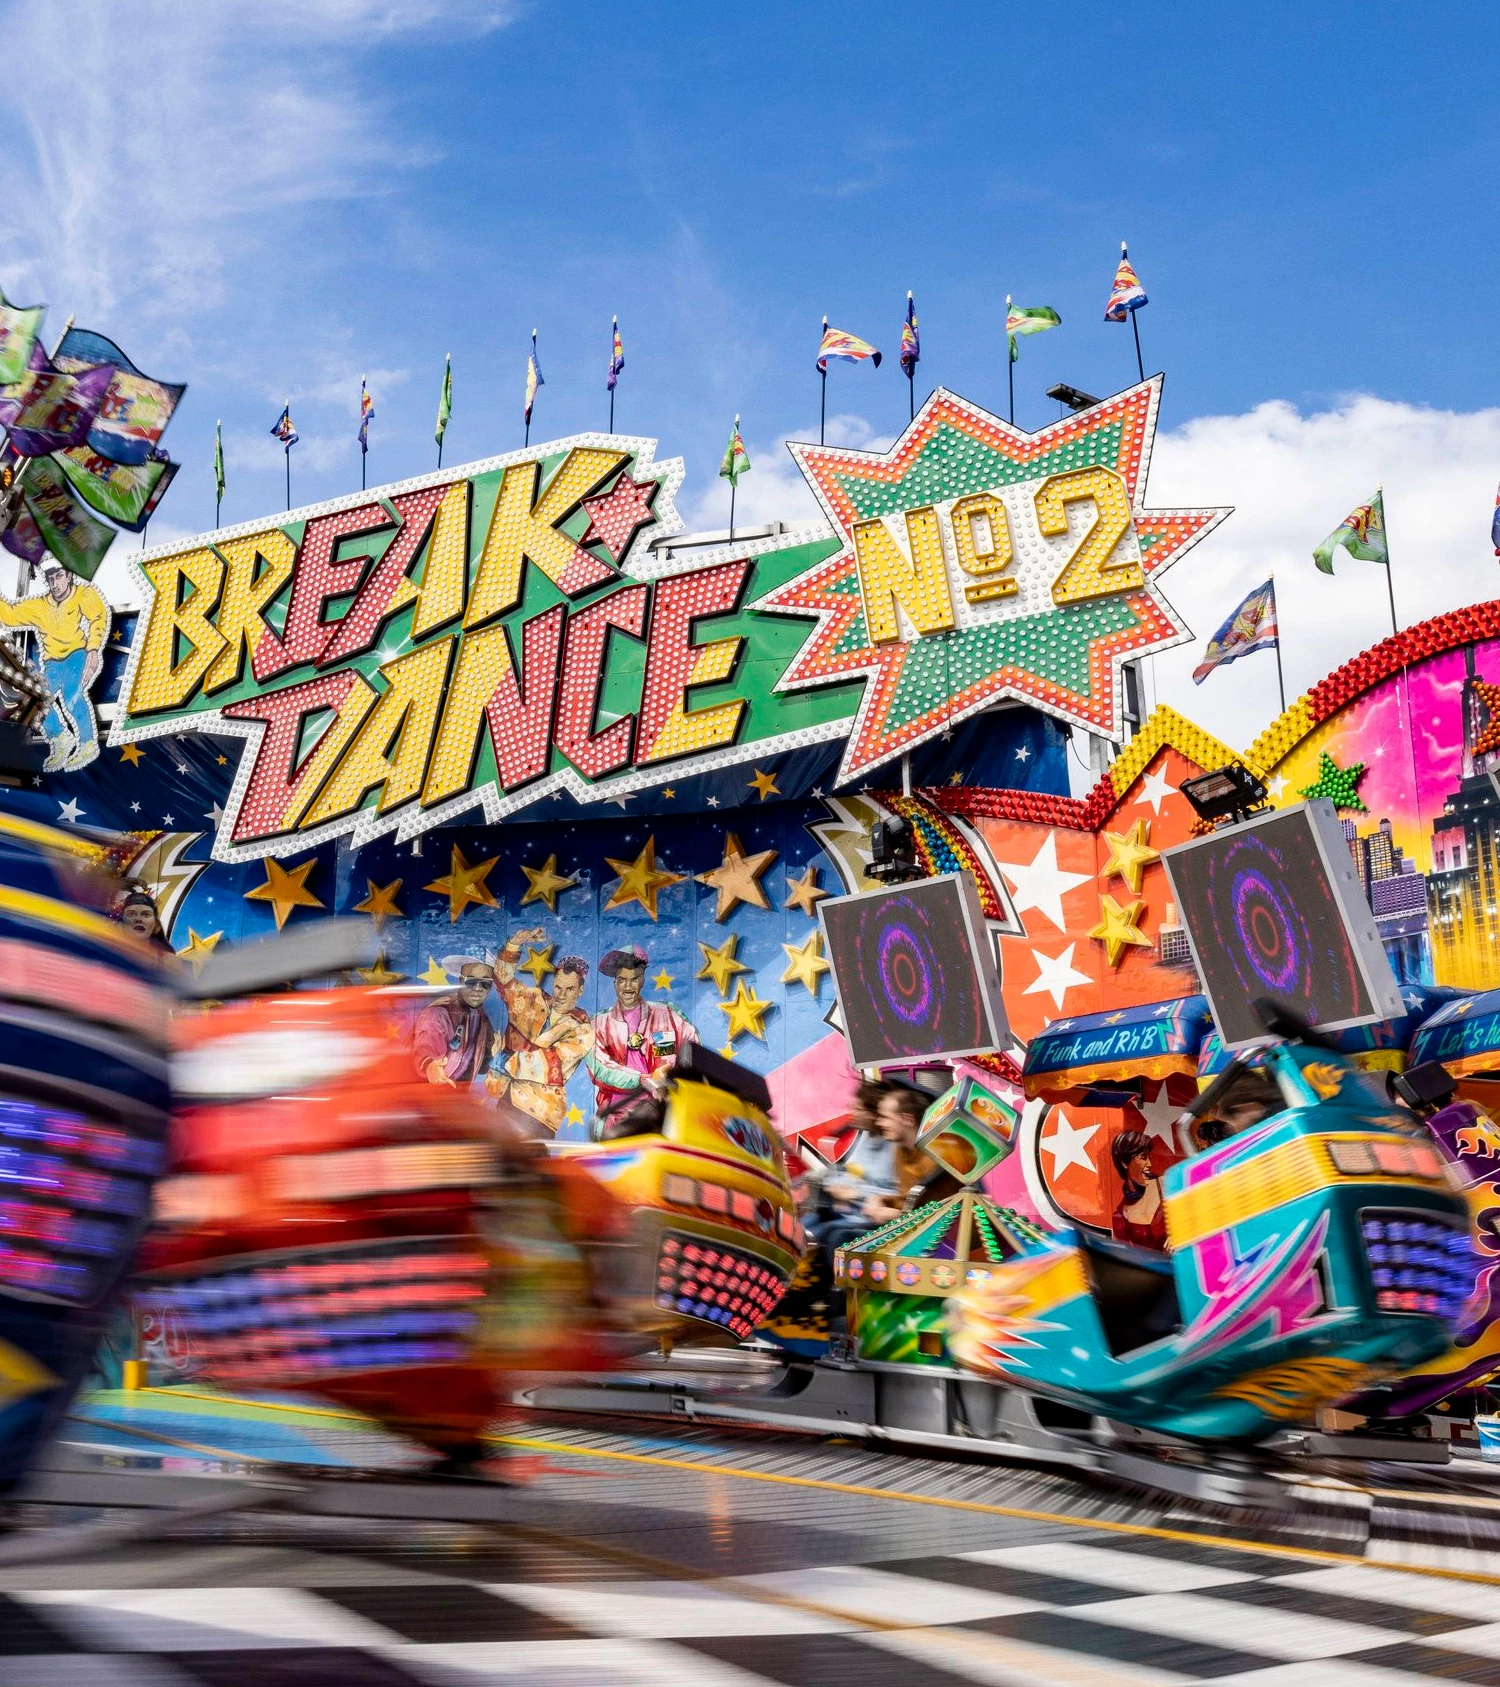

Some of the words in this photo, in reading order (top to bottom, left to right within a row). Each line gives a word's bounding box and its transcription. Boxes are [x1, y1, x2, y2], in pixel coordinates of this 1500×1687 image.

[126, 446, 631, 716] BREAK
[1034, 464, 1146, 607] 2
[220, 557, 754, 845] DANCE
[1041, 1037, 1082, 1065] Funk
[1082, 1029, 1119, 1059] and
[1437, 1020, 1484, 1057] Let's
